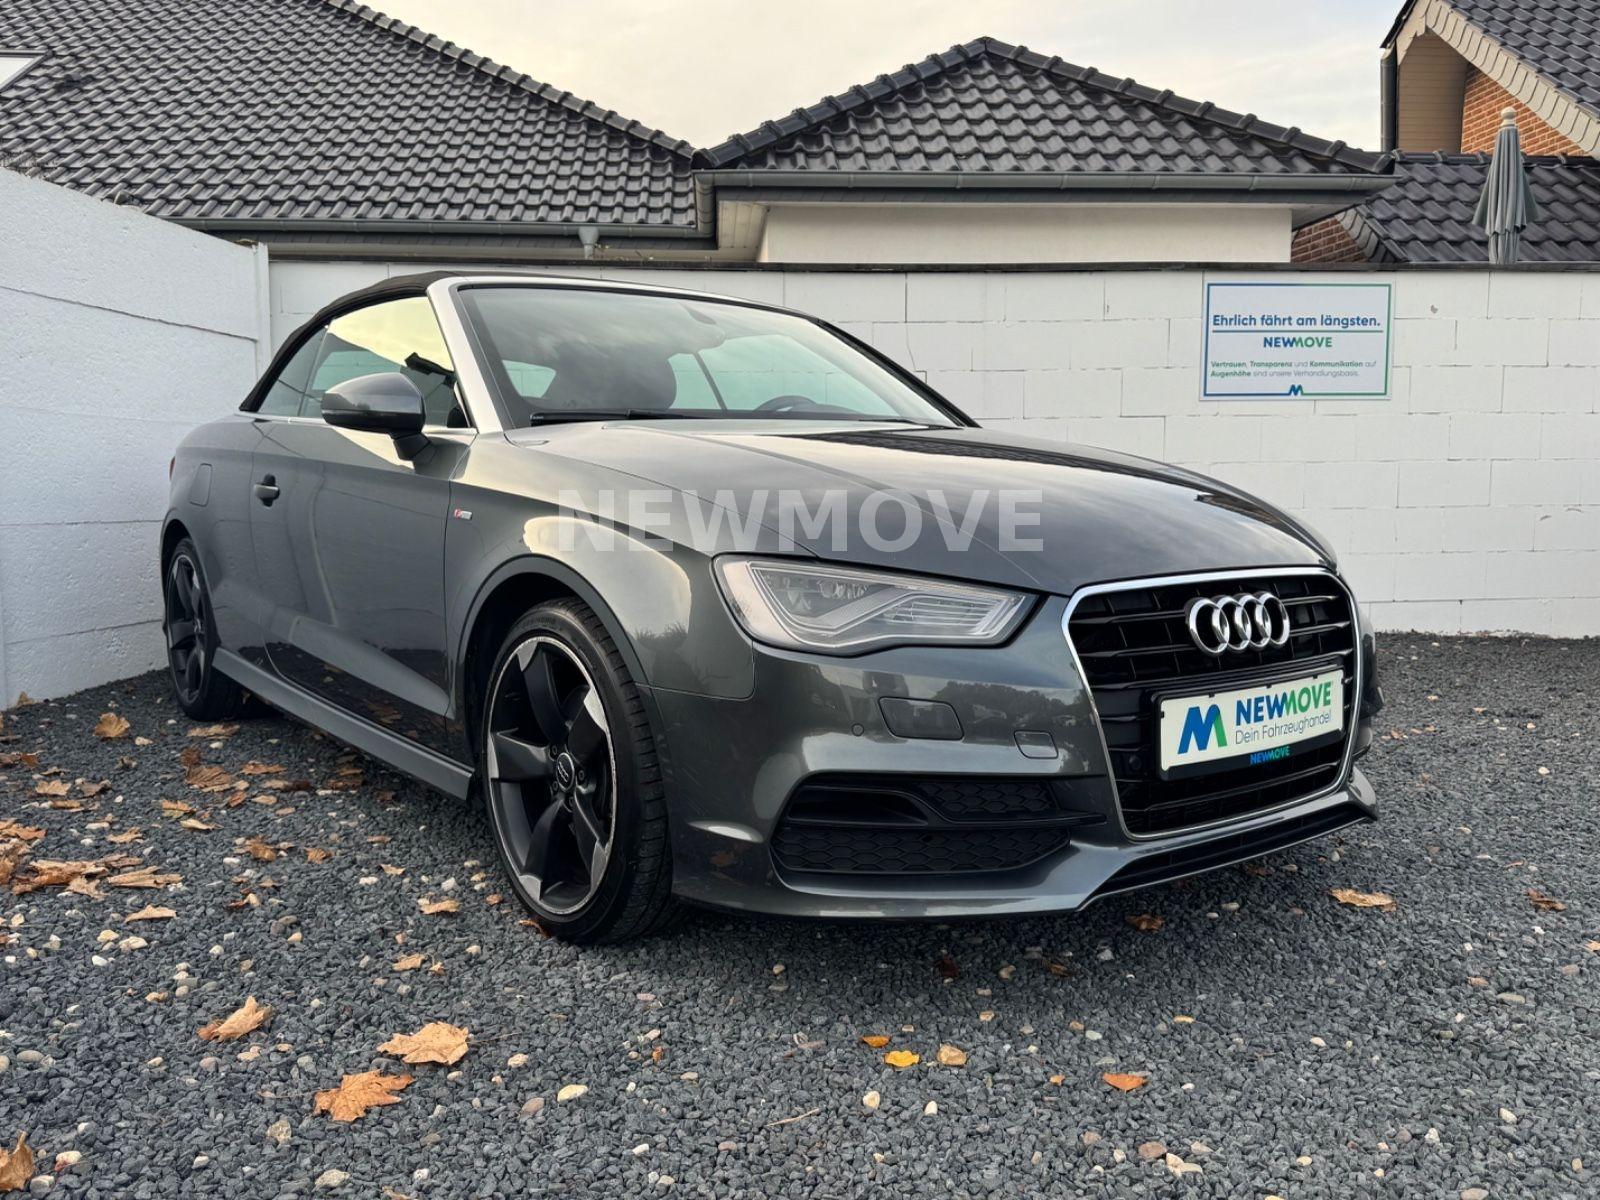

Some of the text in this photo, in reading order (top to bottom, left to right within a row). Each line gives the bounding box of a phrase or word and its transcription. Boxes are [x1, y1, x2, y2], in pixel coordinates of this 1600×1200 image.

[1213, 314, 1381, 329] Ehrlich fährt am längsten.
[1263, 336, 1333, 348] NEWMOVE
[1211, 360, 1247, 369] Vertrauen,
[1249, 360, 1293, 370] Transparenz
[1210, 370, 1252, 378] Augenhöhe
[1235, 681, 1332, 726] NEWMOVE
[1235, 710, 1332, 745] Dein Fahrzeughandel
[1250, 746, 1290, 765] NEWMOVE
